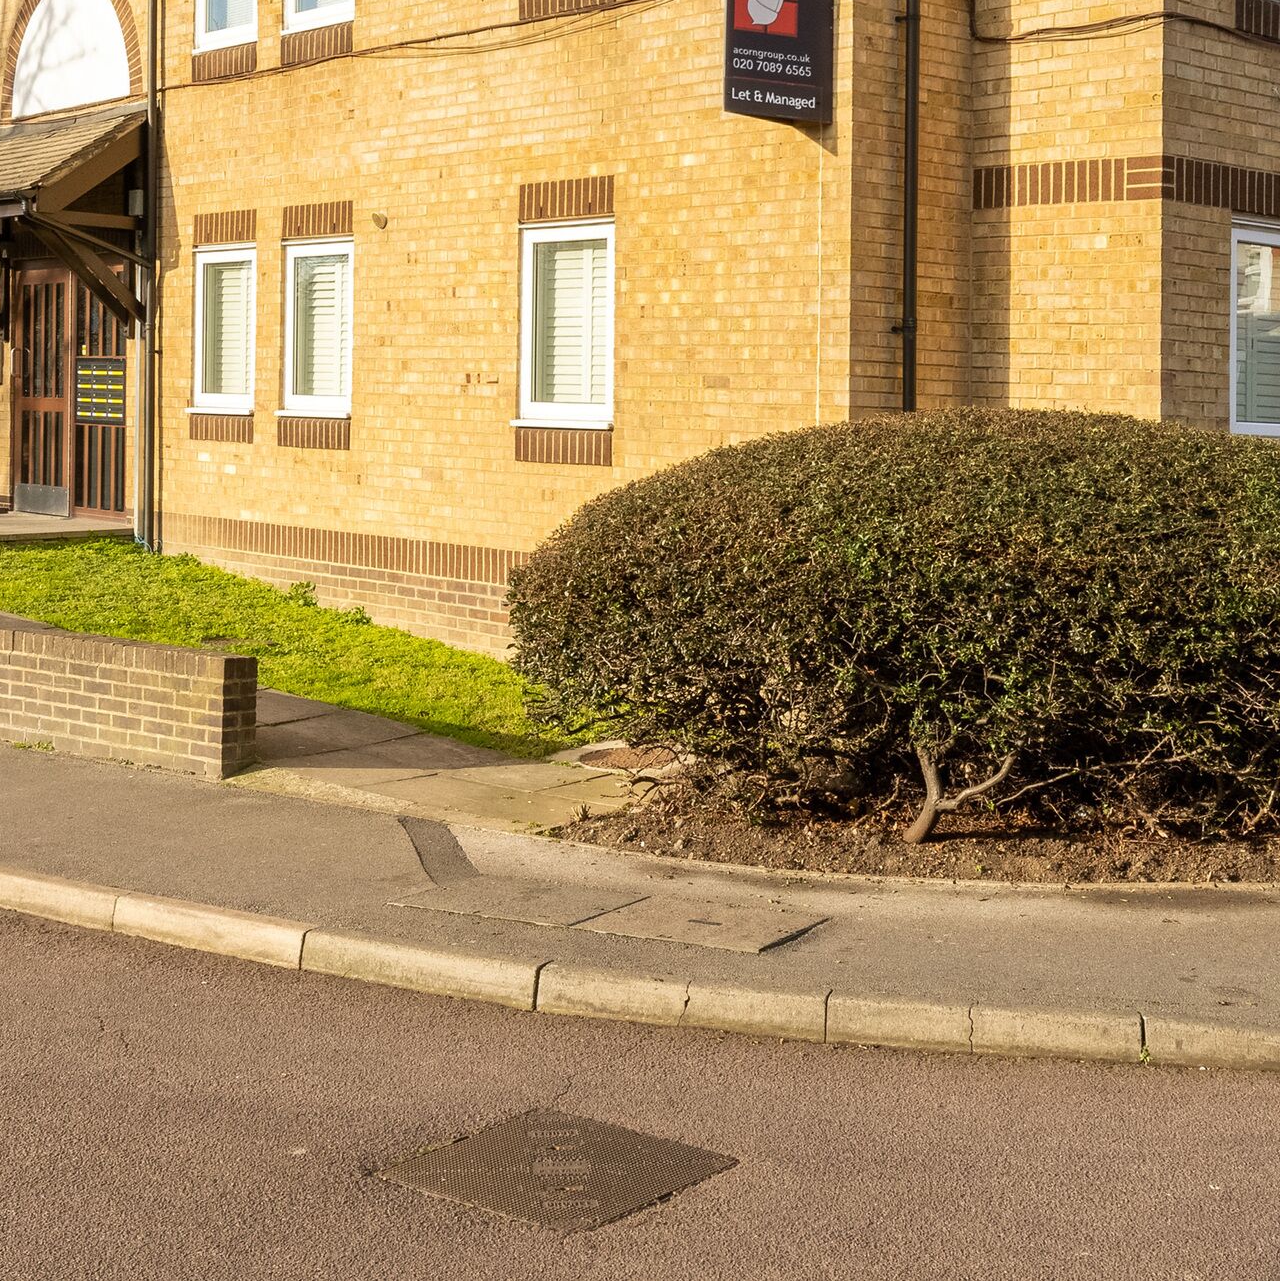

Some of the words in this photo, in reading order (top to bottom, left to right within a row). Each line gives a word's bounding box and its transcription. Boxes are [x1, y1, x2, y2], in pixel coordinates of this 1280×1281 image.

[733, 47, 810, 63] acorngroup.co.uk
[733, 58, 753, 70] 020
[756, 61, 782, 73] 7089
[786, 65, 811, 77] 6565
[732, 87, 751, 101] Let
[754, 90, 763, 102] &
[765, 92, 816, 109] Managed
